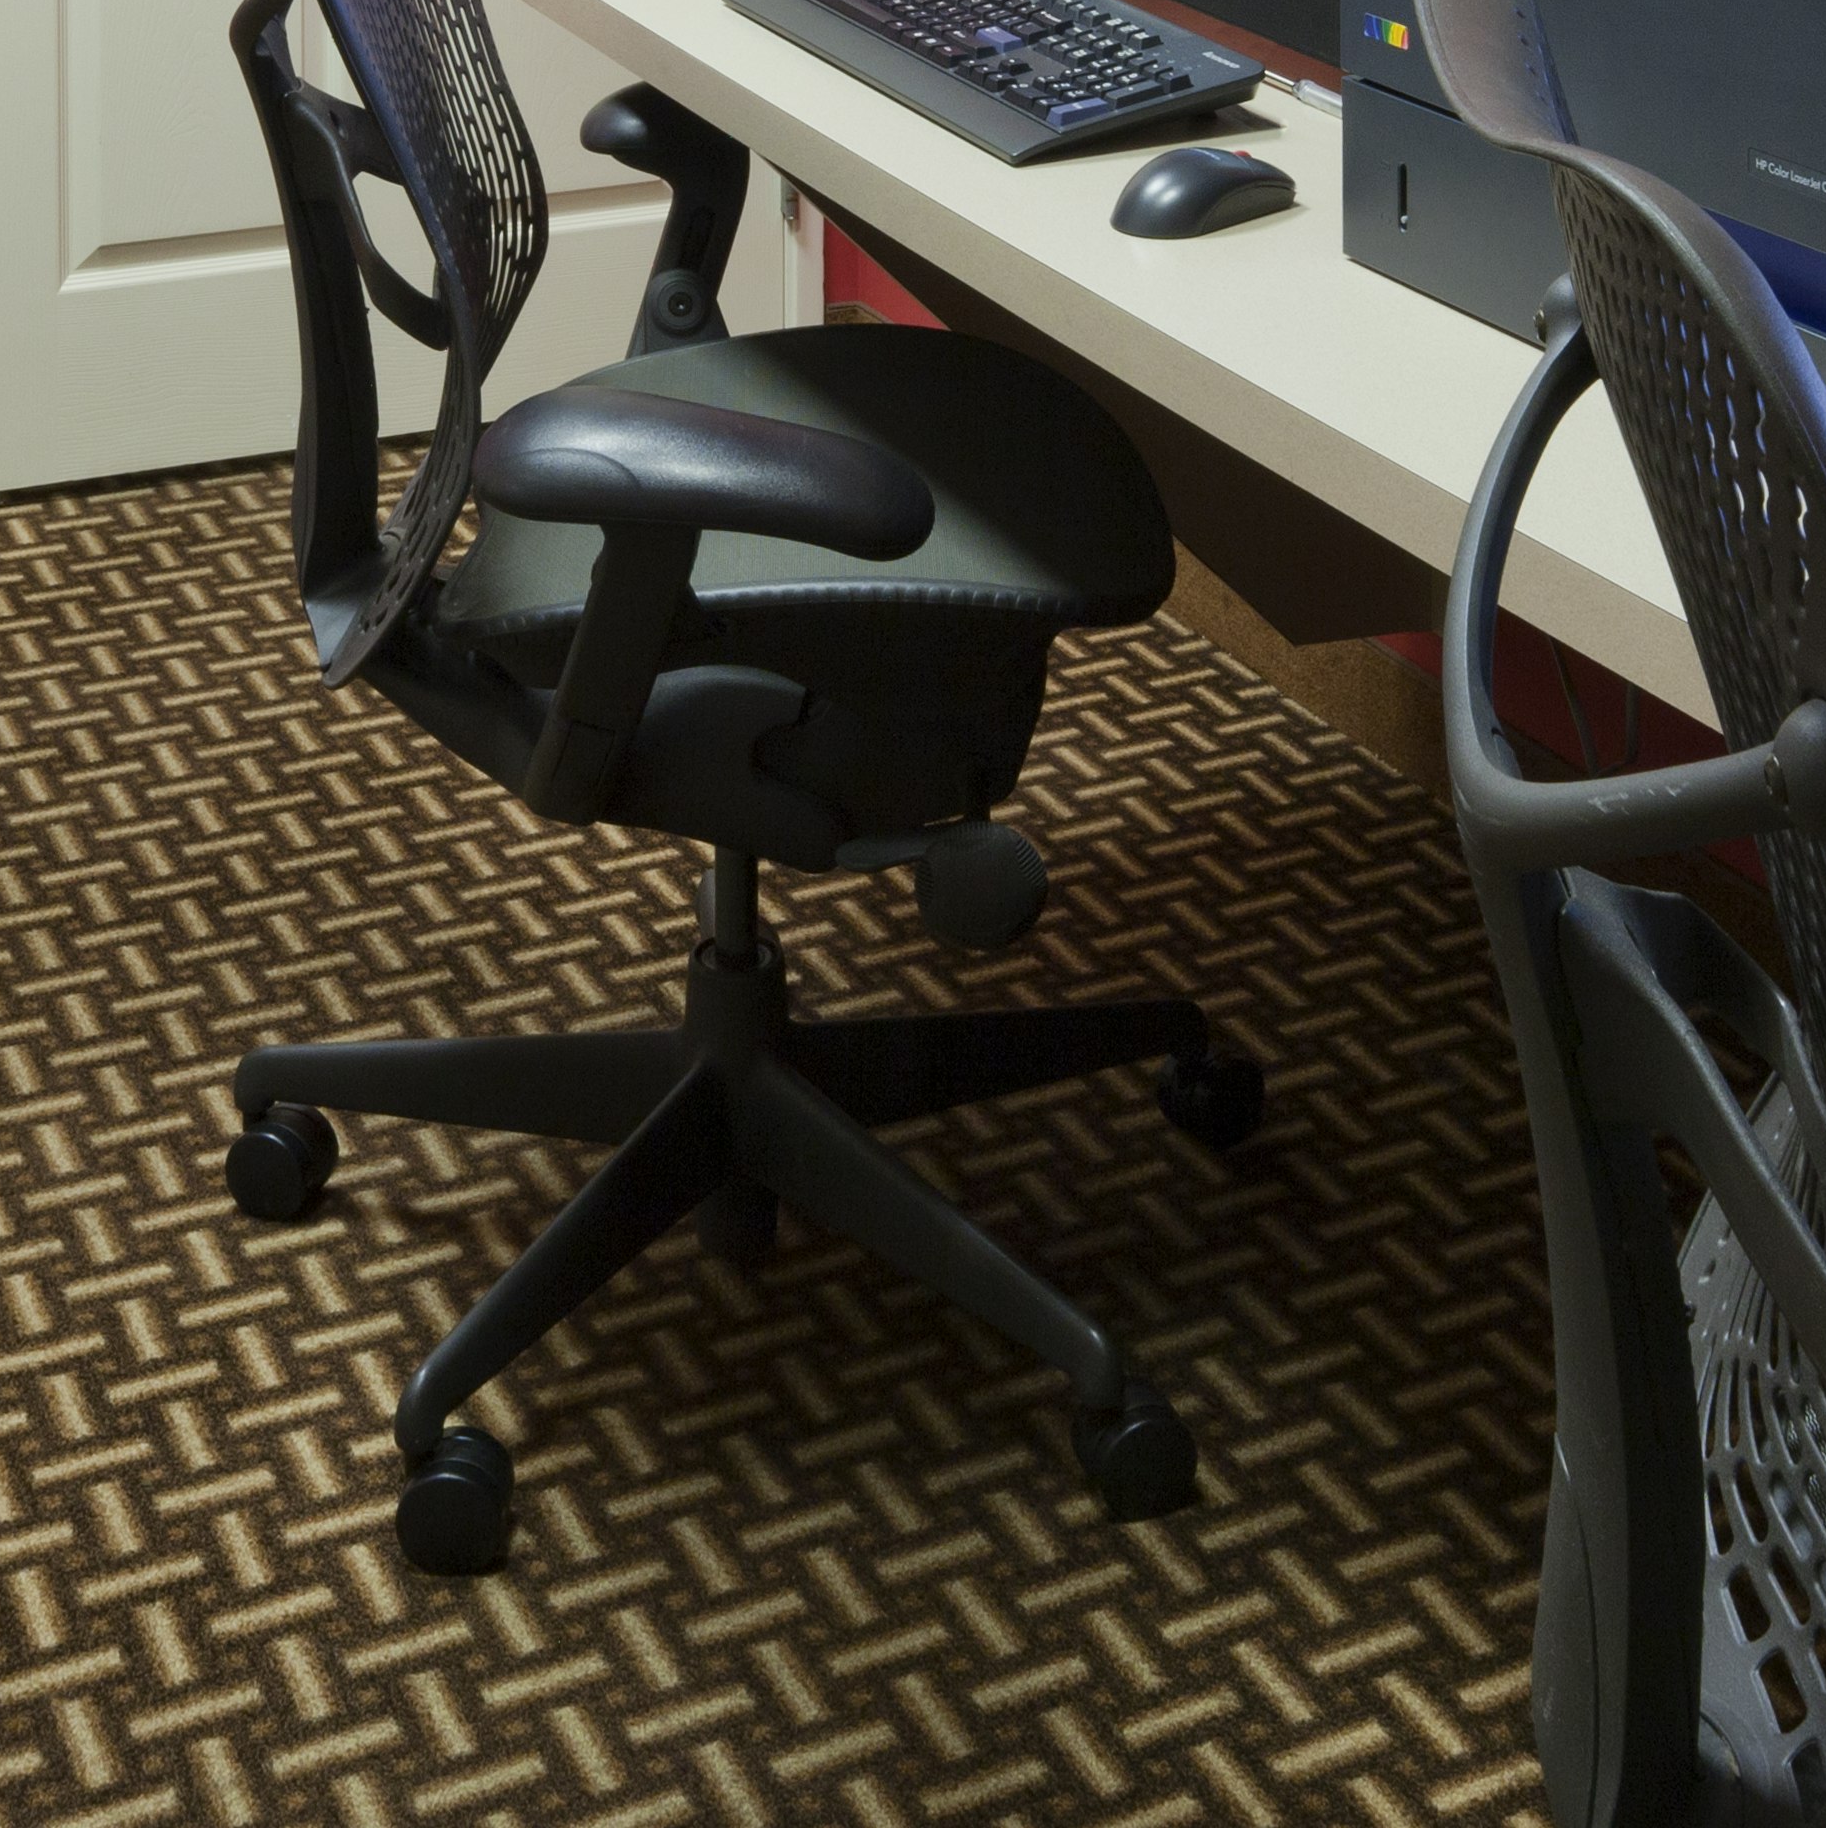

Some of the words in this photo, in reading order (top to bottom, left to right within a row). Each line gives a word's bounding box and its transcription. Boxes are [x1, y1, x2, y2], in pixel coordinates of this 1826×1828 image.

[1755, 157, 1768, 171] HP
[1768, 162, 1790, 179] Color
[1790, 170, 1822, 191] LaserJet
